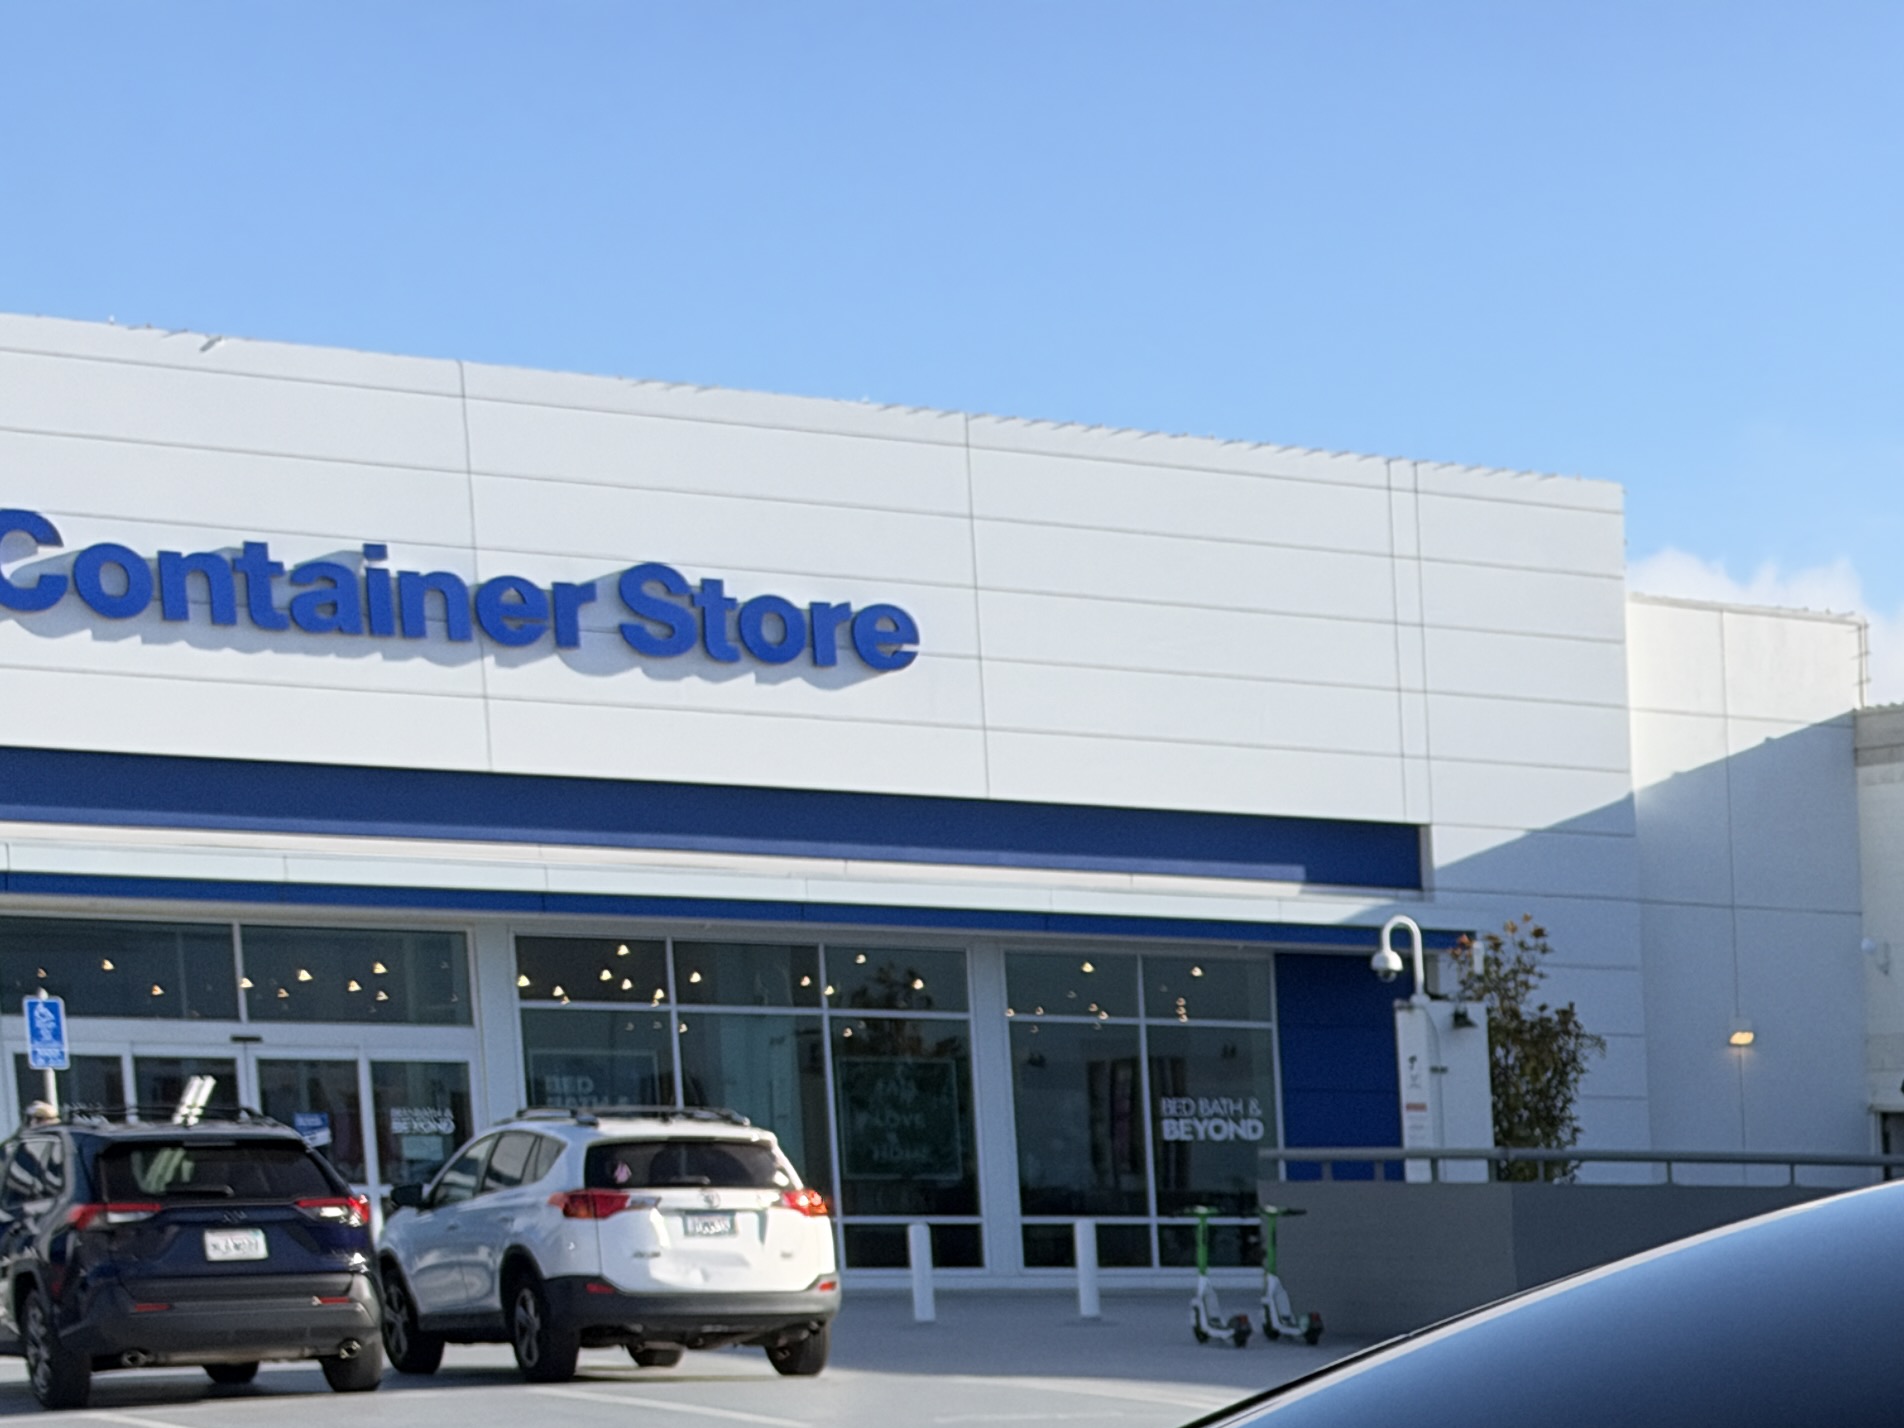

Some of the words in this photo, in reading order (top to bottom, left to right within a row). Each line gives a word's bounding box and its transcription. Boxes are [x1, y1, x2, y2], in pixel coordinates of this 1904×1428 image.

[0, 508, 596, 649] Container
[618, 561, 921, 673] Store
[1162, 1096, 1196, 1117] BED
[1199, 1096, 1244, 1116] BATH
[1248, 1096, 1262, 1117] &
[1163, 1117, 1265, 1142] BEYOND
